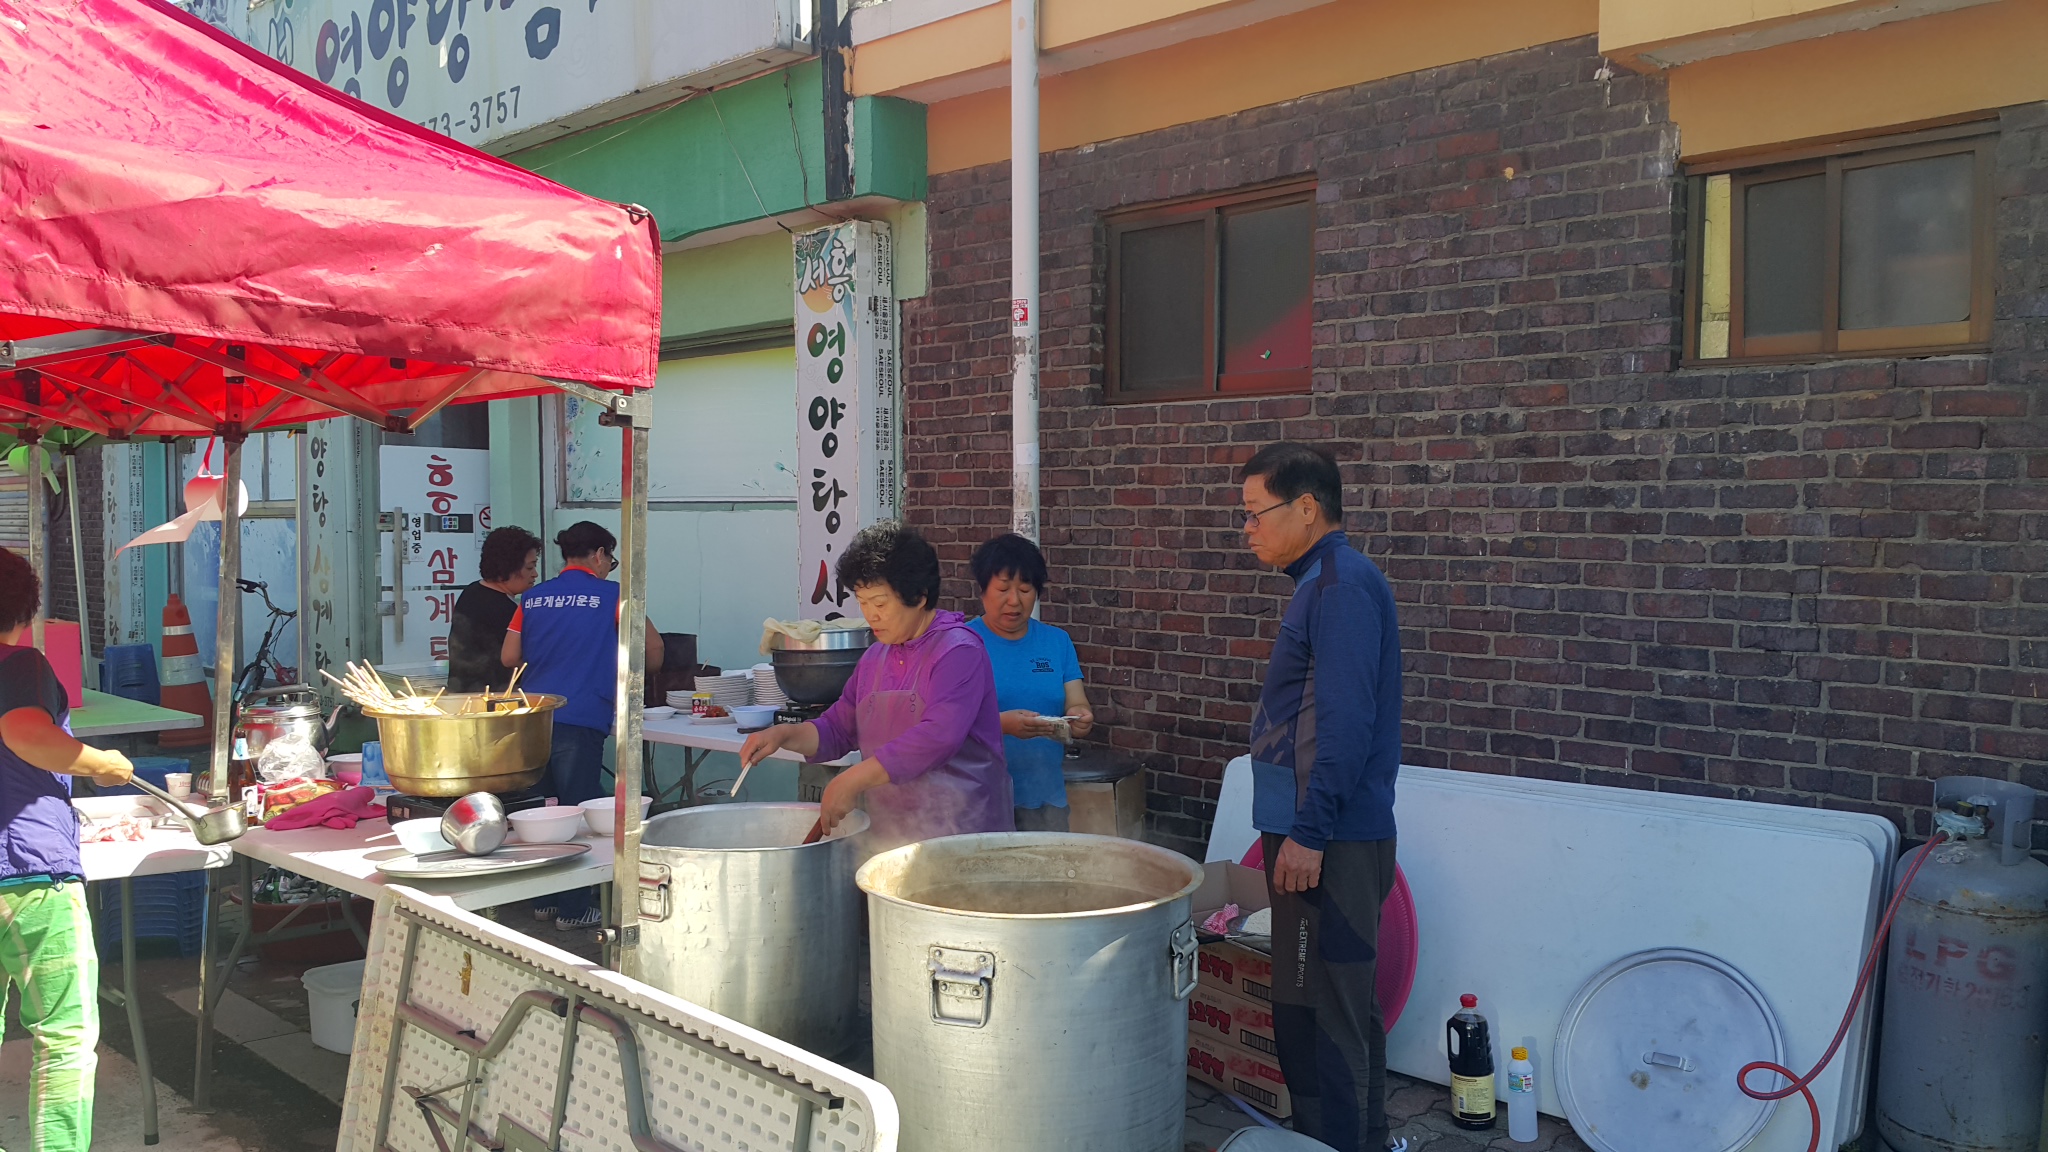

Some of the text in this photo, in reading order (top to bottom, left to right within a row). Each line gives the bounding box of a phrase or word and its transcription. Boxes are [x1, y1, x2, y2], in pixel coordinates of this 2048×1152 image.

[418, 85, 521, 138] 73-3757
[799, 237, 853, 304] 서흥
[411, 516, 422, 554] 영업중
[524, 594, 601, 610] 바르게살기운동
[1906, 929, 2016, 982] LPG
